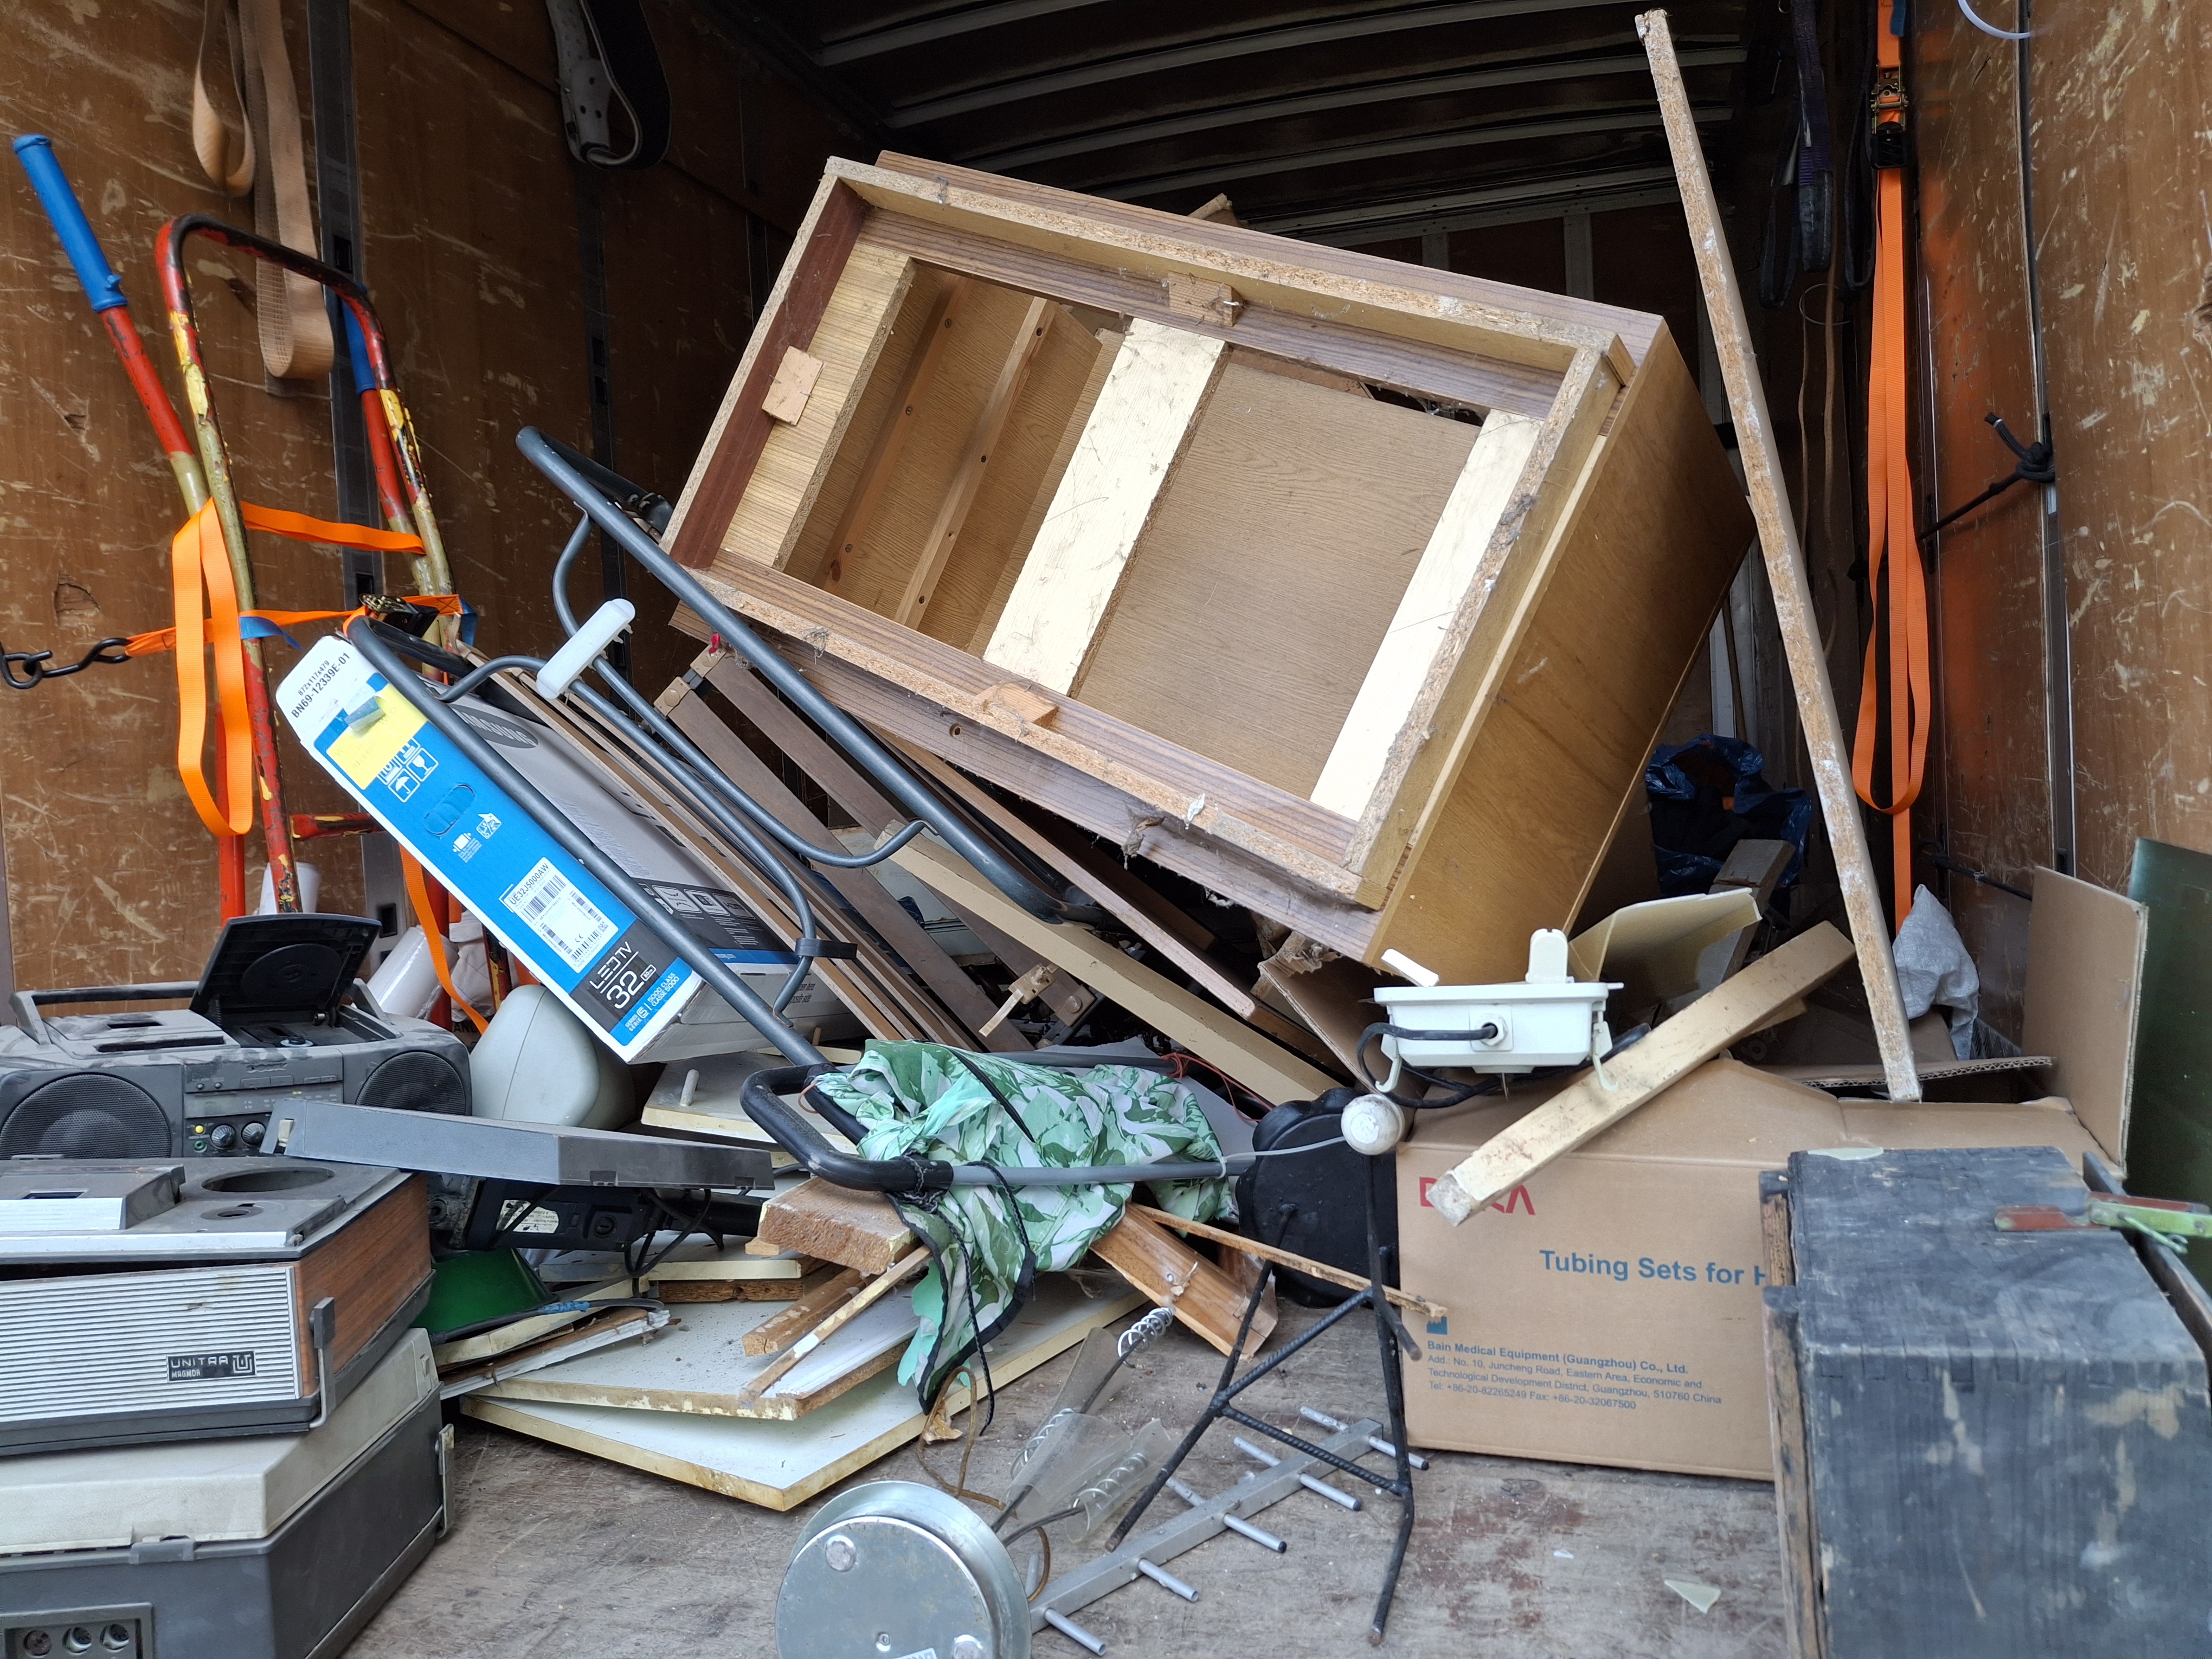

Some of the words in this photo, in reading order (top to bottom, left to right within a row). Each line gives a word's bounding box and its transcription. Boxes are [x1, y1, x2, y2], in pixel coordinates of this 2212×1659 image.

[291, 652, 350, 718] BN69-12339E-01
[451, 708, 538, 746] AMSUNG
[510, 863, 549, 905] UE32J5000AW
[614, 941, 632, 959] TV
[606, 970, 645, 1009] 32
[661, 972, 675, 988] CLASS
[665, 976, 679, 992] 5000
[1539, 1250, 1629, 1282] Tubing
[1638, 1257, 1697, 1282] Sets
[1706, 1262, 1745, 1284] for
[171, 1355, 228, 1368] UNITRA
[1427, 1341, 1451, 1352] Bain
[1455, 1343, 1496, 1356] Medical
[1500, 1347, 1559, 1363] Equipment
[1563, 1354, 1636, 1371] (Guangzhou)
[1640, 1361, 1663, 1373] Co.,
[1667, 1363, 1688, 1374] Ltd.
[1454, 1358, 1468, 1366] No.
[1472, 1359, 1486, 1369] 10,
[1489, 1361, 1533, 1375] Juncheng
[1535, 1365, 1563, 1377] Road,
[1566, 1368, 1602, 1379] Eastern
[1605, 1372, 1630, 1383] Area,
[1634, 1374, 1680, 1387] Economic
[1683, 1380, 1702, 1388] and
[1428, 1367, 1489, 1382] Technological
[1491, 1374, 1552, 1388] Development
[1554, 1380, 1590, 1392] District,
[1592, 1384, 1650, 1398] Guangzhou,
[1654, 1391, 1689, 1401] 510760
[1693, 1393, 1722, 1404] China
[1429, 1380, 1443, 1390] Tel:
[1529, 1391, 1549, 1401] Fax:
